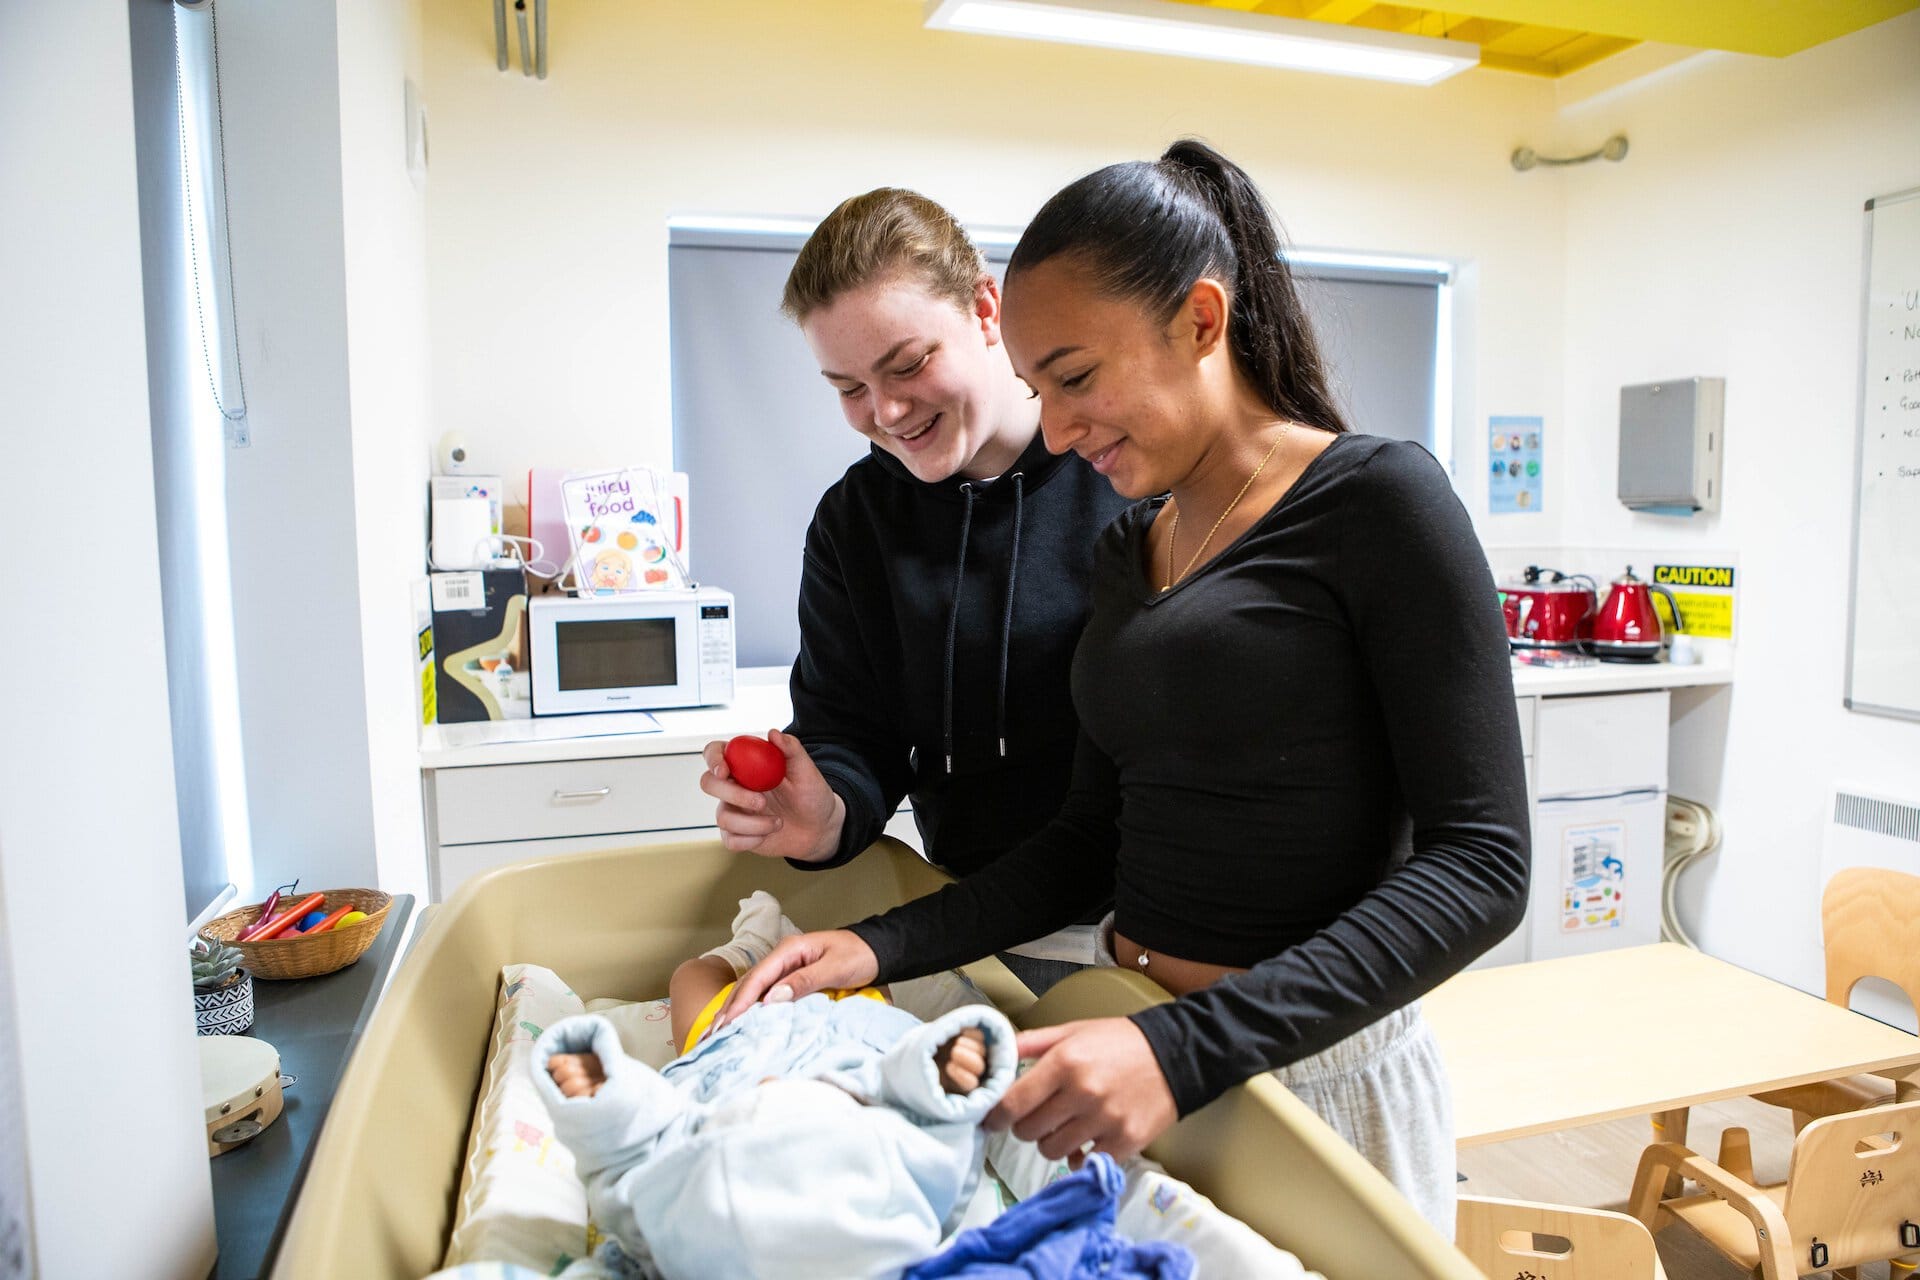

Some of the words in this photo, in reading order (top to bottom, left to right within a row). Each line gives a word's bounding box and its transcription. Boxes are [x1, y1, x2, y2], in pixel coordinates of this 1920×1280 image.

[584, 480, 630, 503] juicy
[590, 497, 634, 517] food
[1656, 566, 1731, 586] CAUTION
